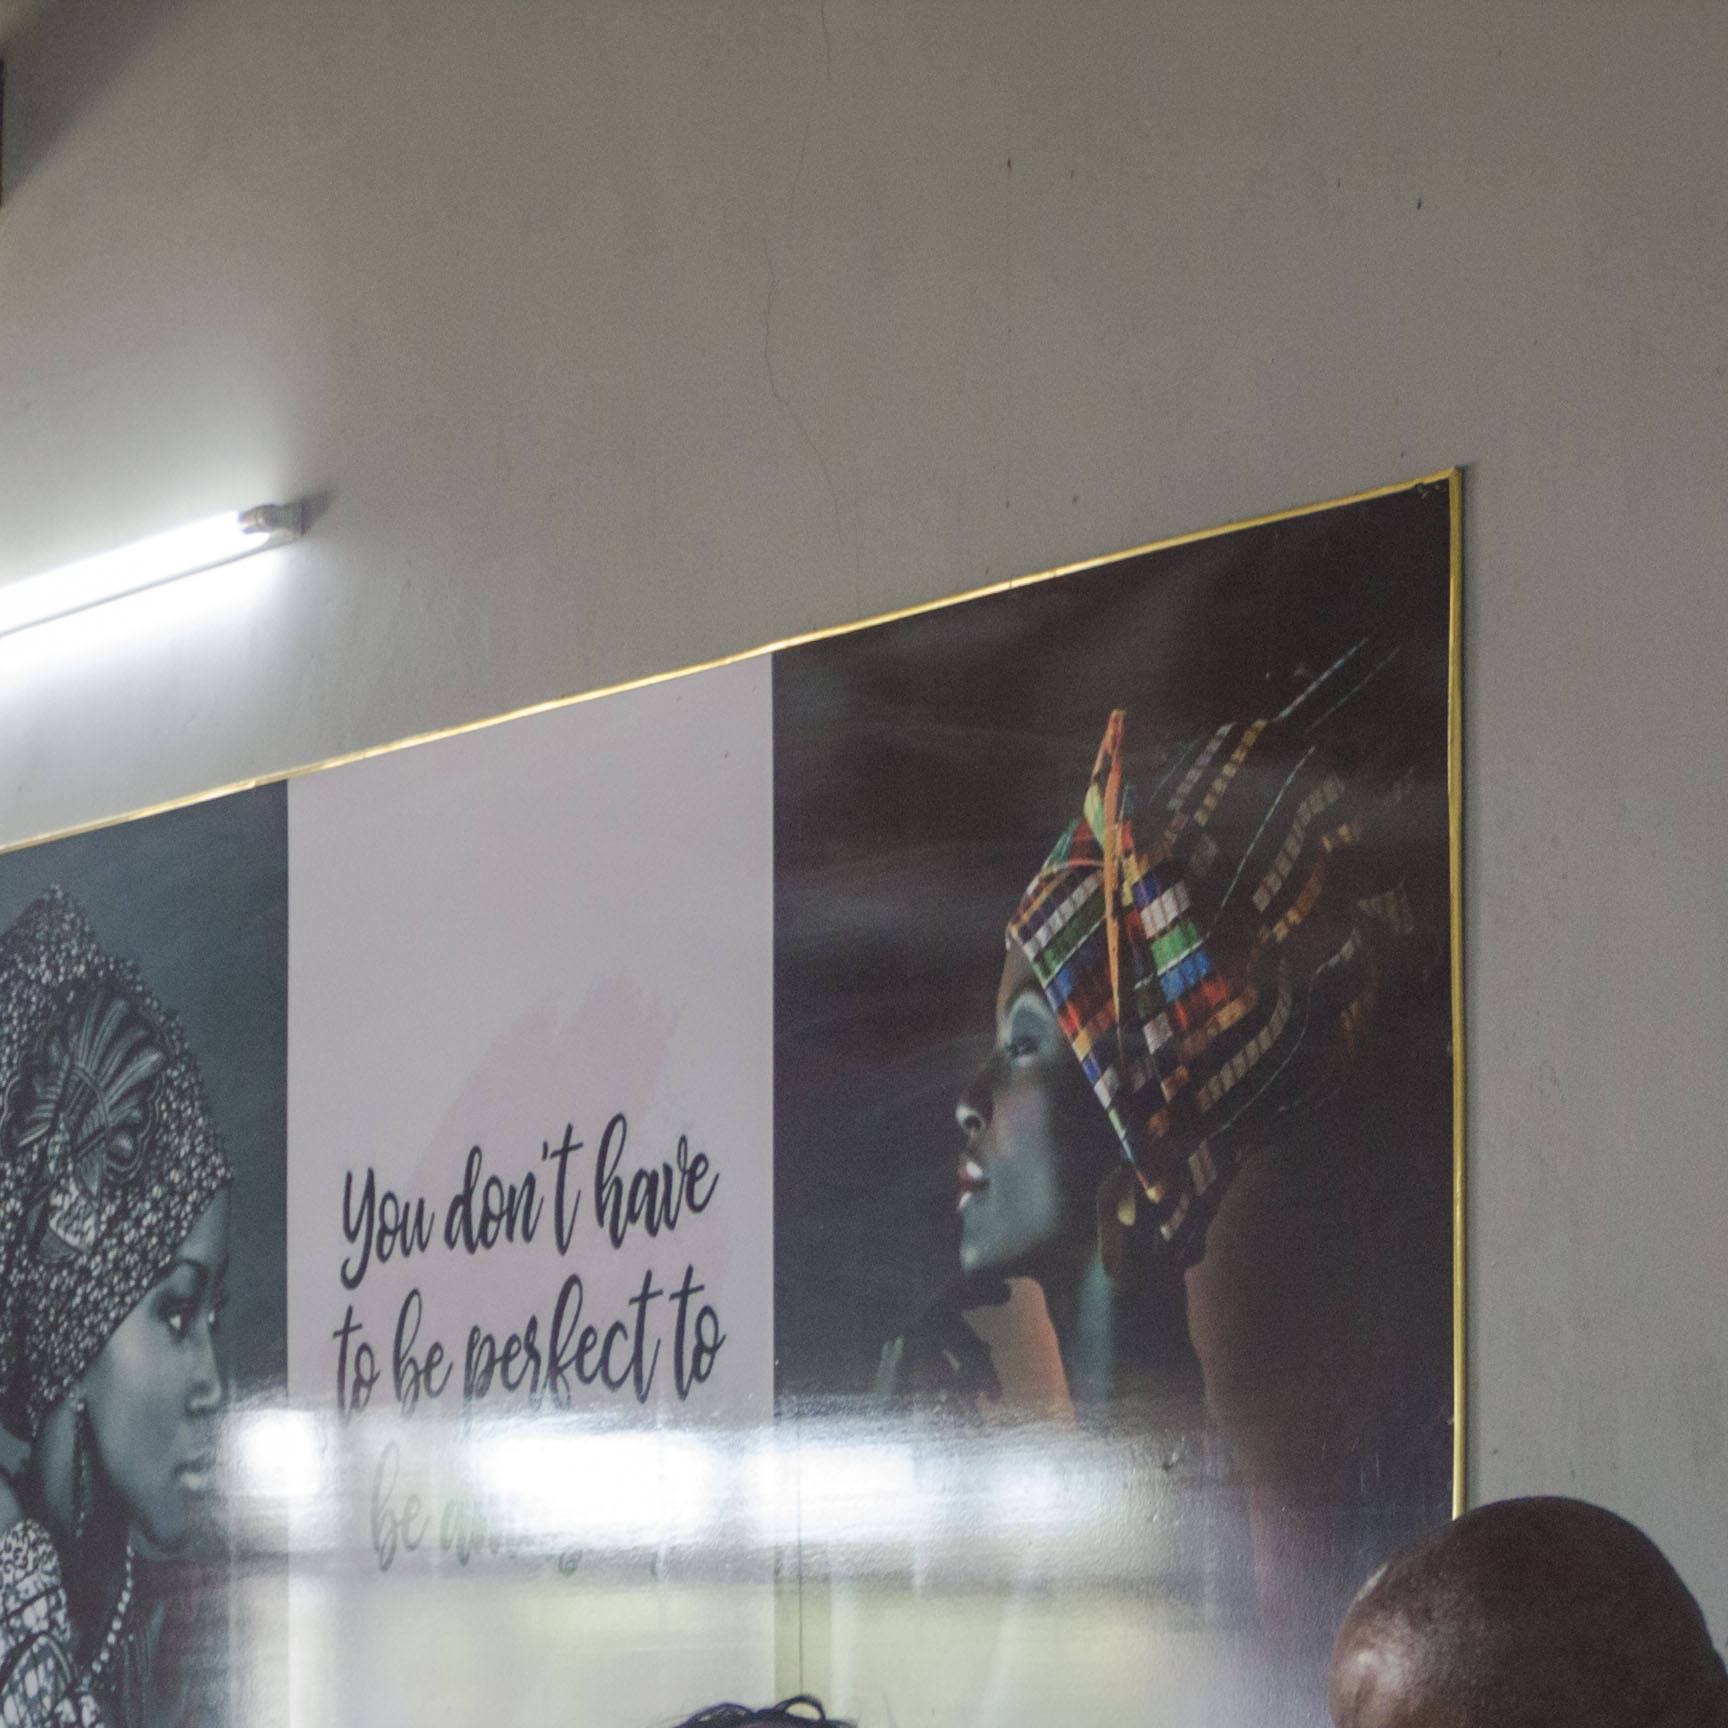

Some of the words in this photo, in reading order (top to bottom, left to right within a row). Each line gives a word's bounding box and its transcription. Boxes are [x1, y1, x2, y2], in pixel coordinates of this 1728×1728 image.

[341, 1167, 435, 1290] You
[445, 1123, 584, 1255] don't
[594, 1113, 720, 1250] have
[333, 1305, 380, 1431] to
[393, 1288, 453, 1420] be
[463, 1269, 663, 1424] perfect
[669, 1264, 726, 1401] to
